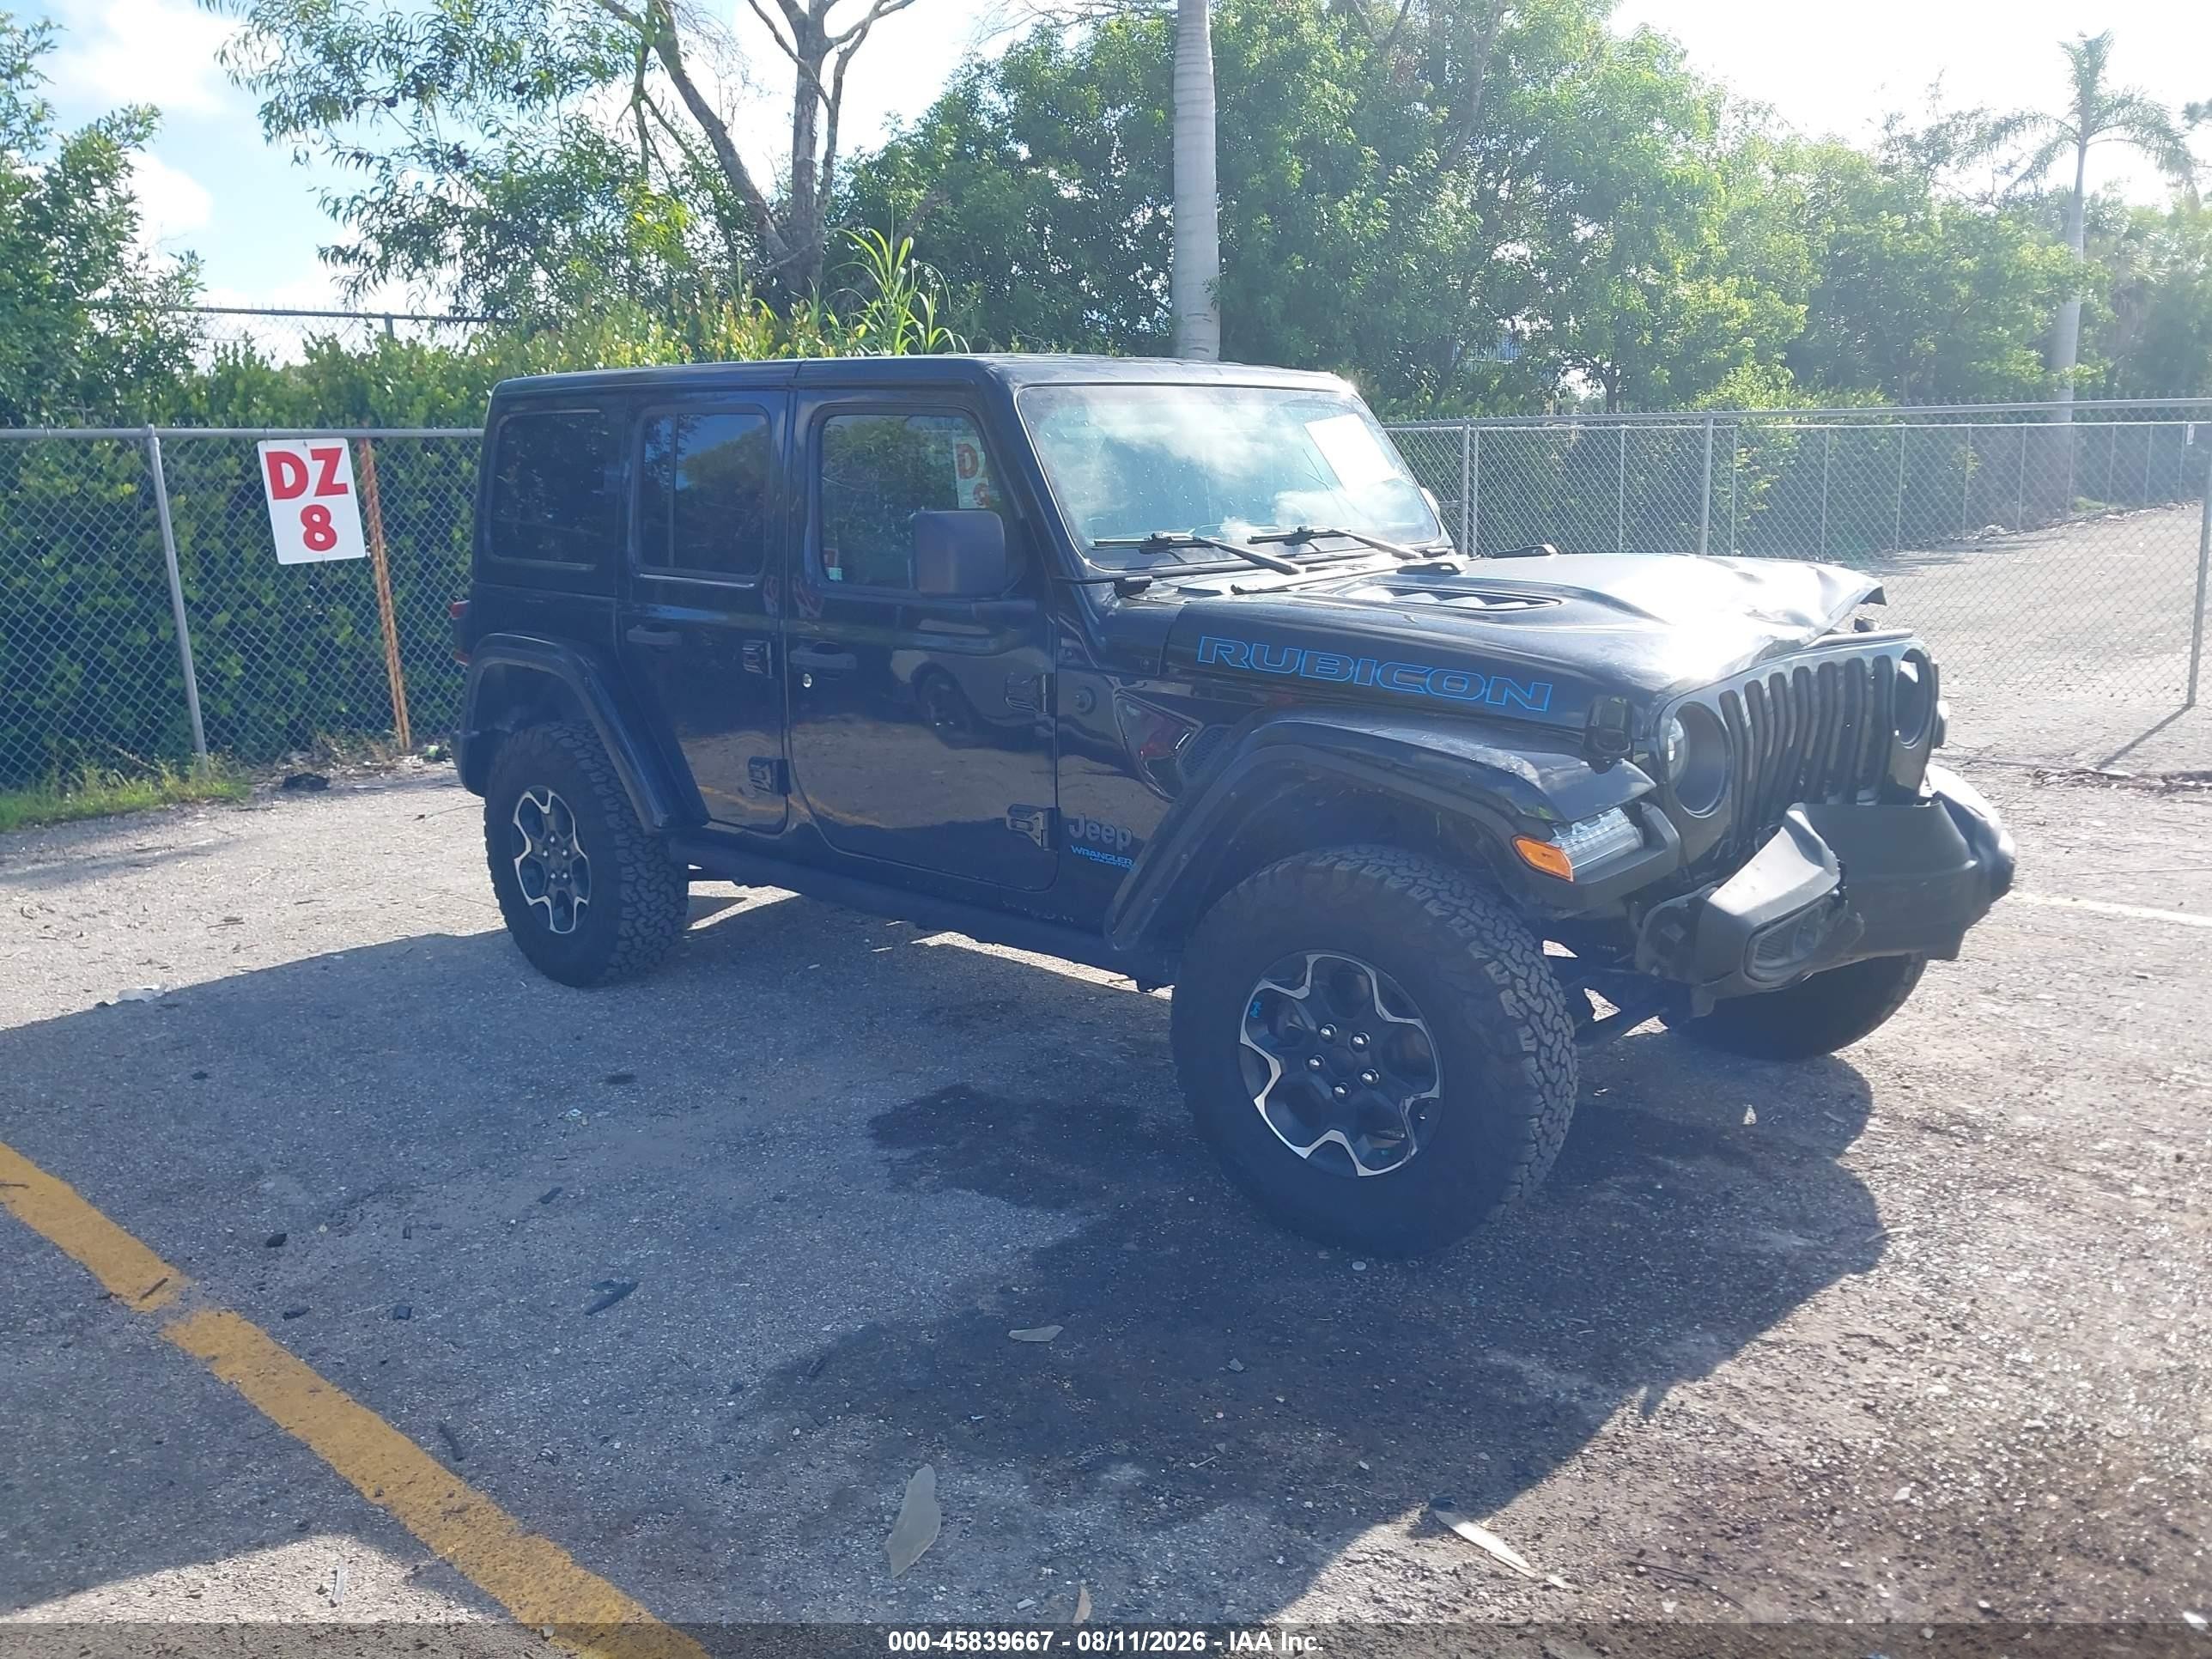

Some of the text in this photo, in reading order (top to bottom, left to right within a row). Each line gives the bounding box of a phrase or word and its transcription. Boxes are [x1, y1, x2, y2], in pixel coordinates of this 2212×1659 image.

[265, 447, 349, 501] DZ
[956, 443, 979, 479] D
[301, 504, 337, 551] 8
[1197, 636, 1553, 712] RUBICON
[1068, 812, 1133, 852] Jeep
[1070, 845, 1133, 866] WRANGLER
